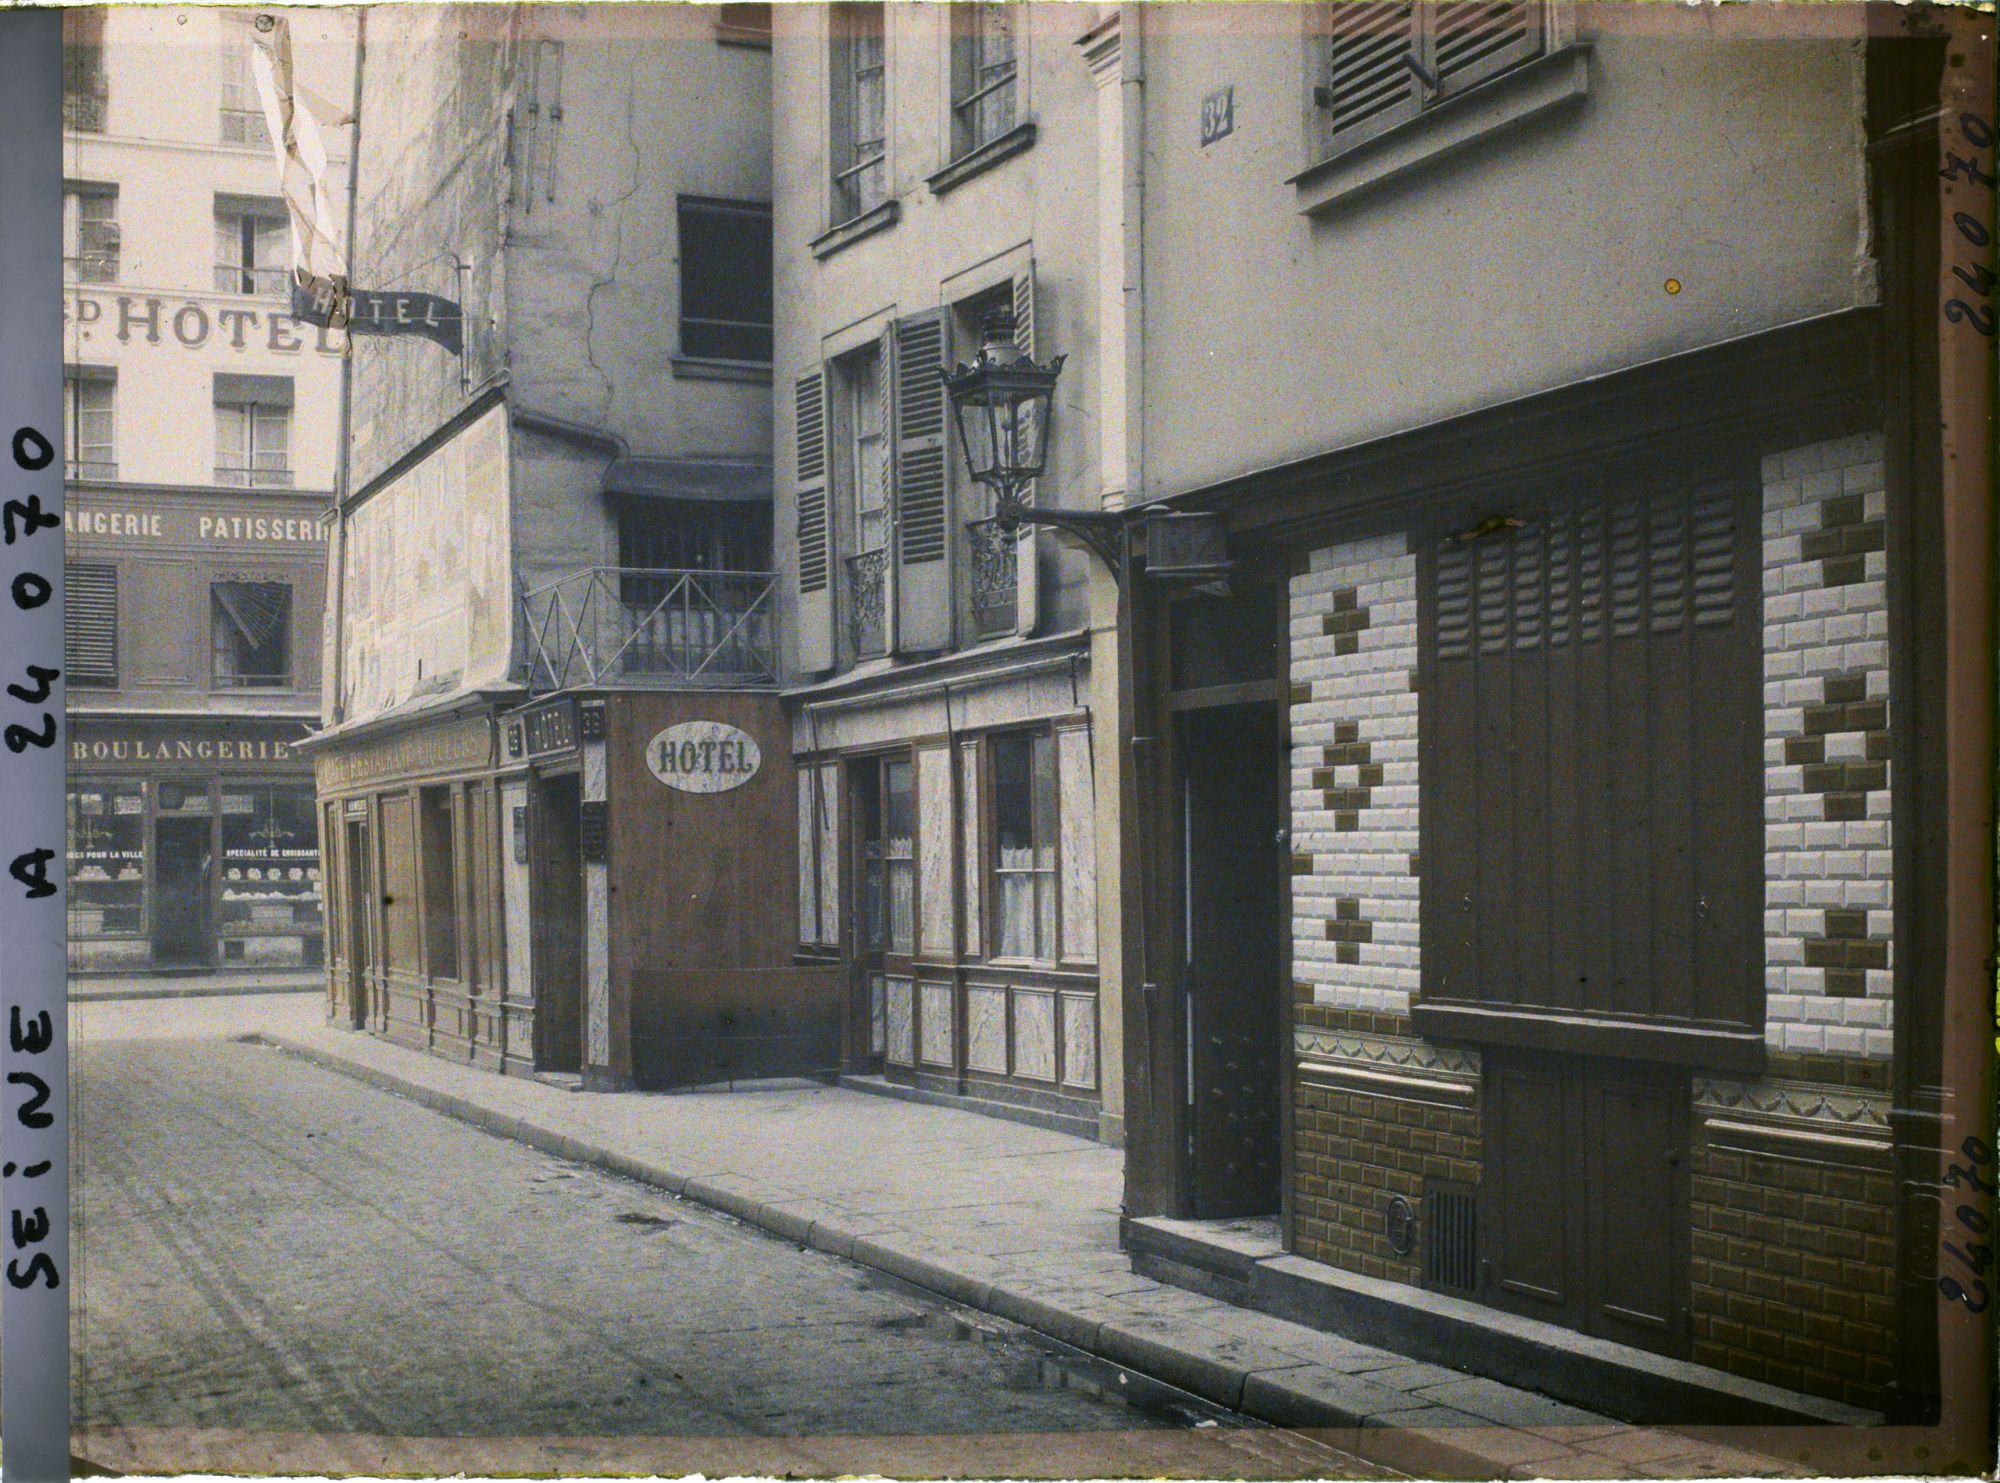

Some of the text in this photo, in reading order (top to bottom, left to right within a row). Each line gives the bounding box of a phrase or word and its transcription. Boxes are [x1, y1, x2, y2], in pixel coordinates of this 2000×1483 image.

[1204, 94, 1229, 138] 32
[1939, 112, 1994, 337] 24070
[4, 426, 61, 754] 24070
[72, 741, 289, 760] BOULANGERIE
[9, 847, 58, 899] A
[86, 851, 107, 859] POUR
[109, 851, 120, 859] LA
[270, 849, 280, 857] DE
[1939, 1136, 1995, 1314] 24070
